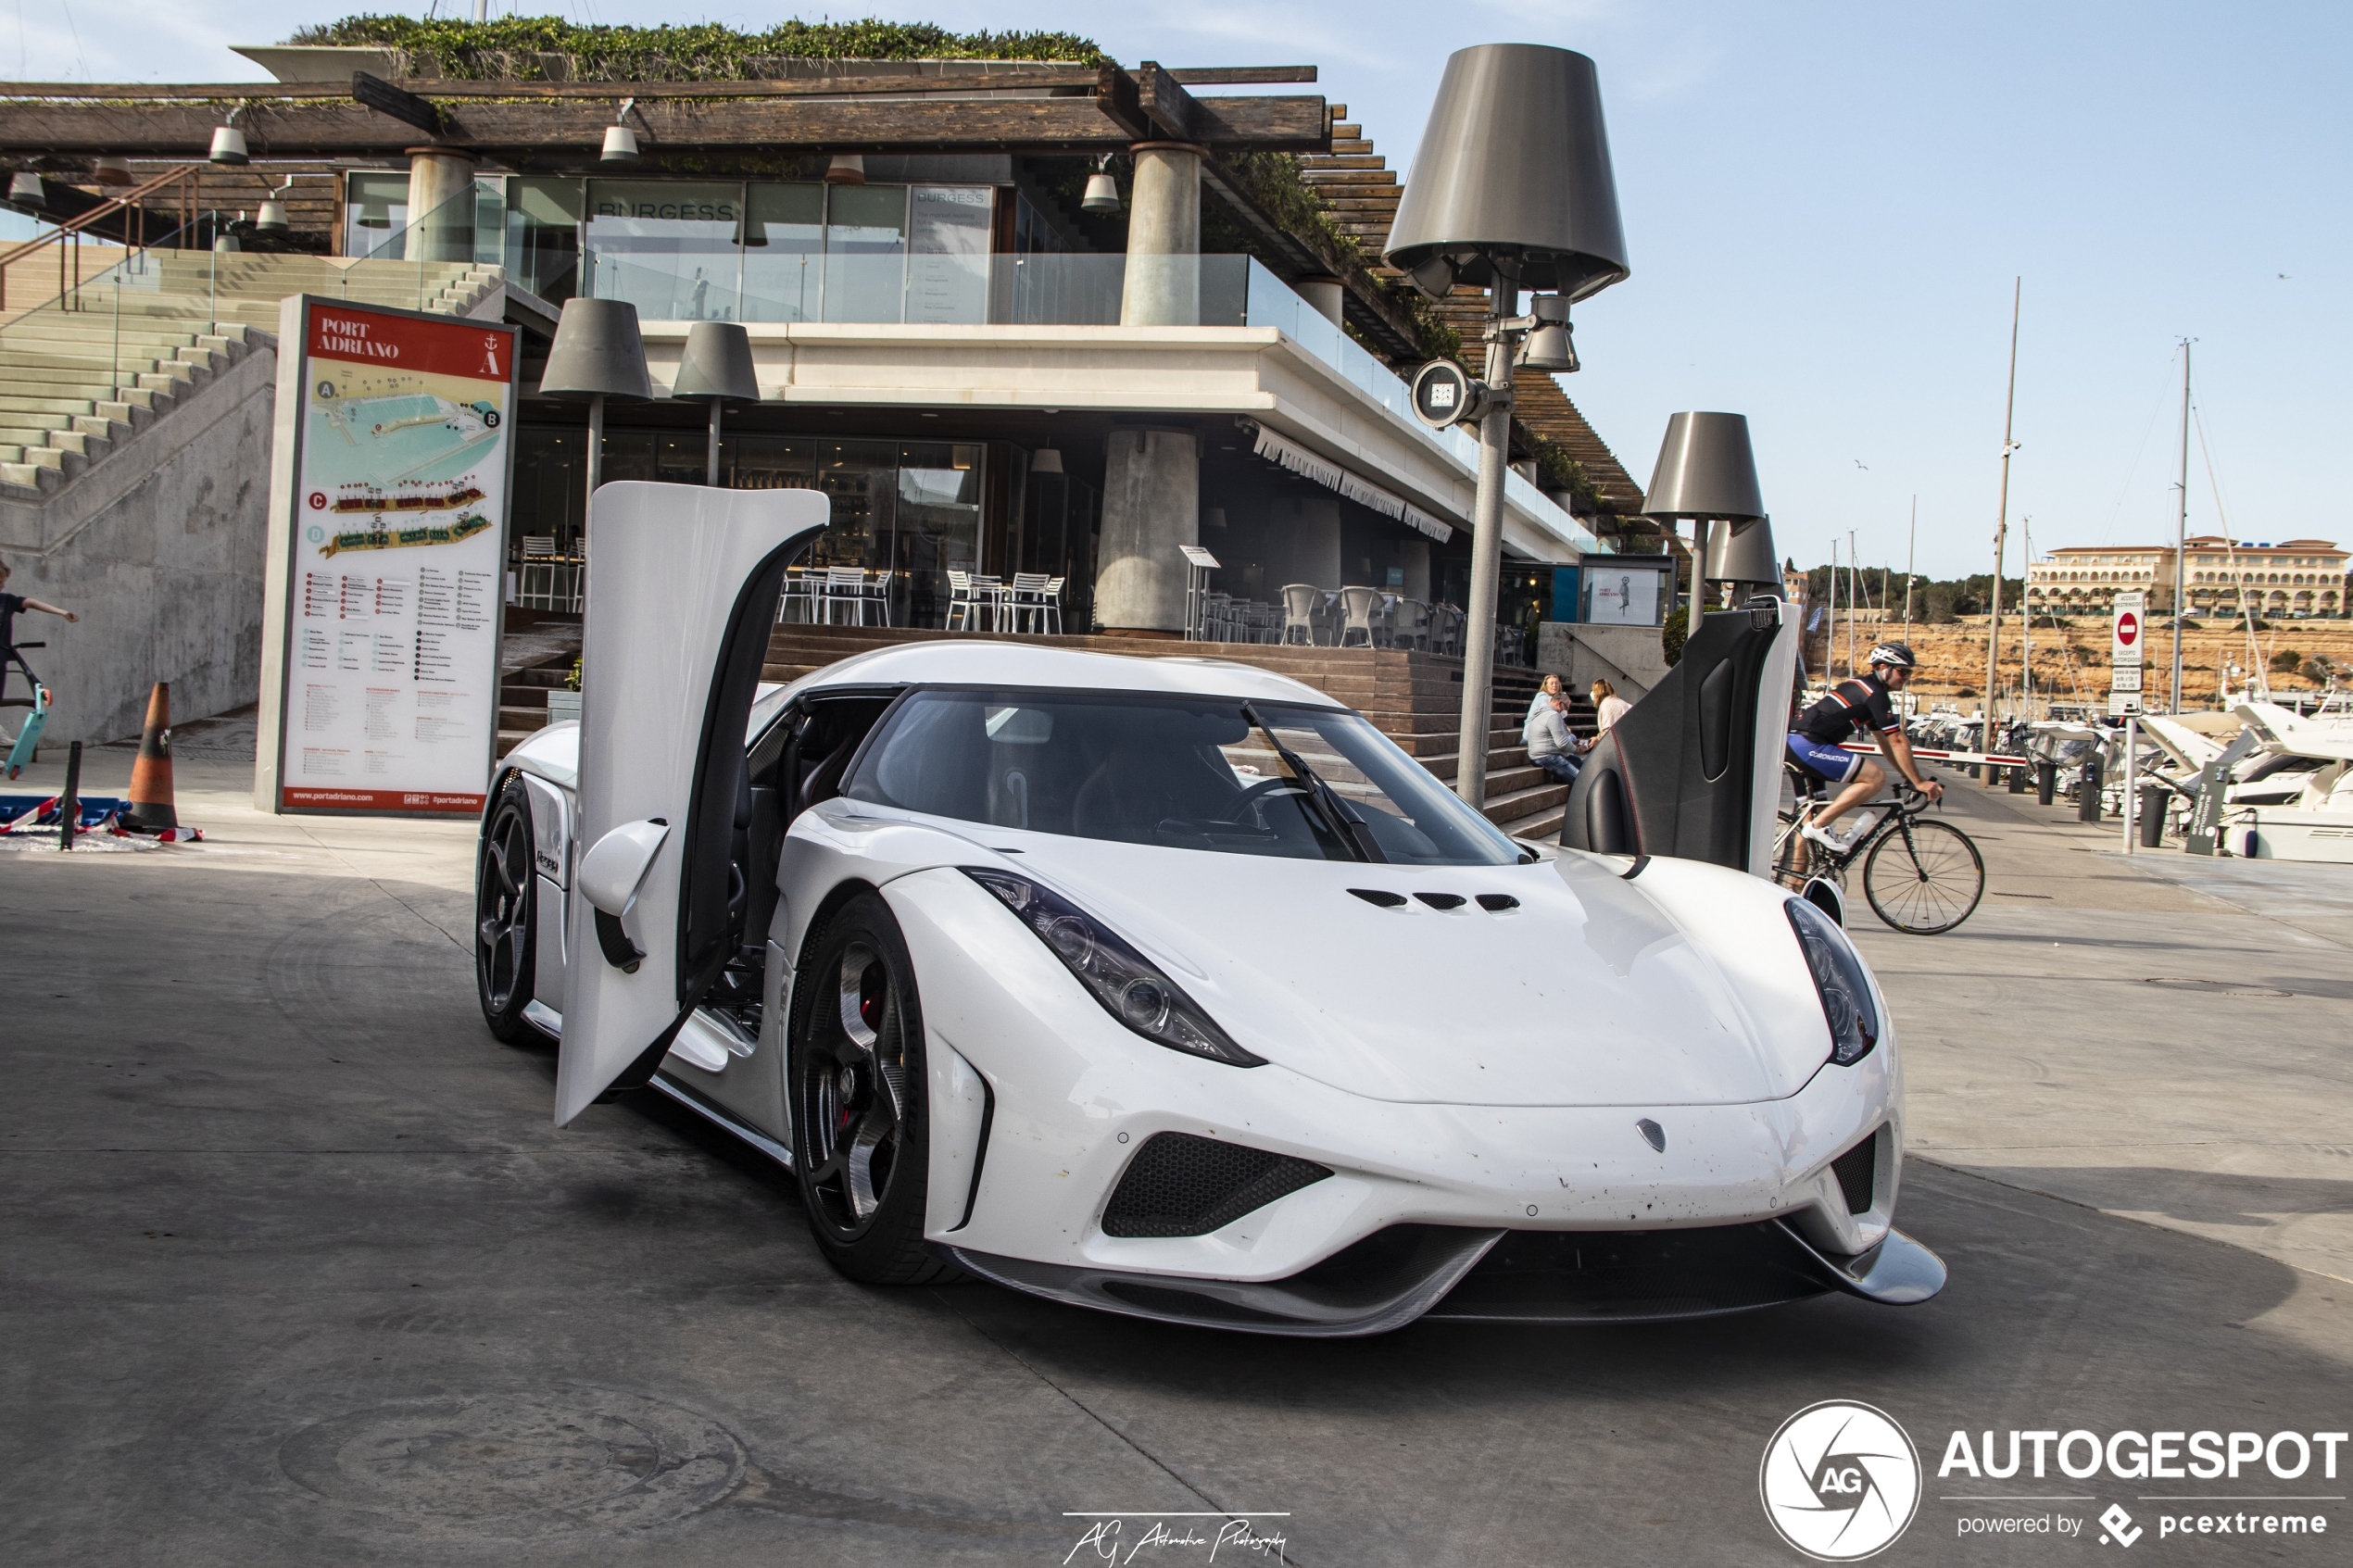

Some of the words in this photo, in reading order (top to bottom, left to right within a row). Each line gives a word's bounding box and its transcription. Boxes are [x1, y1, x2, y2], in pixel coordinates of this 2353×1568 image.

[917, 193, 984, 204] BURGESS
[598, 203, 734, 223] BURGESS
[321, 318, 371, 337] PORT
[317, 335, 399, 359] ADRIANO
[478, 351, 501, 375] A
[321, 384, 332, 396] A
[487, 413, 497, 426] B
[313, 495, 322, 508] C
[1808, 750, 1850, 763] CORONATION
[293, 792, 372, 802] www.portadriano.com
[433, 797, 478, 805] #portadriano
[2192, 794, 2206, 835] engineers
[2201, 783, 2208, 793] of
[2198, 795, 2212, 836] emotions
